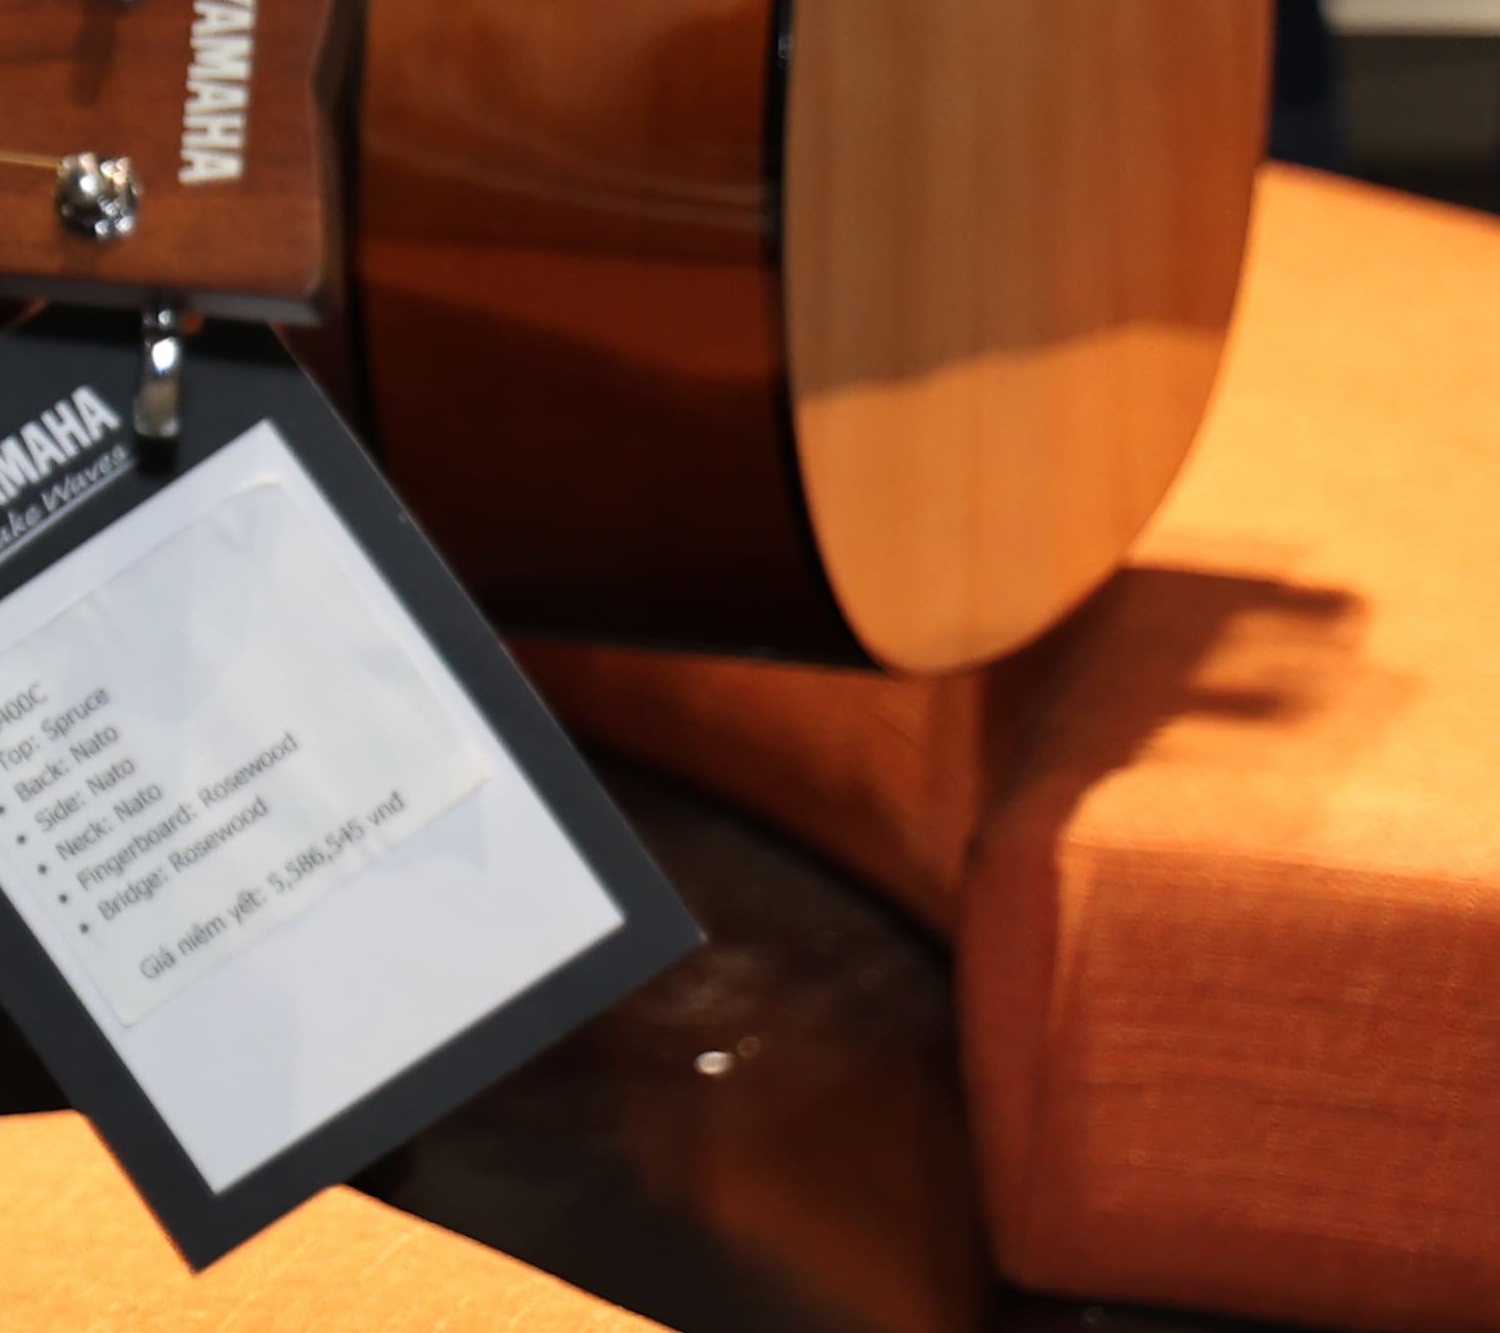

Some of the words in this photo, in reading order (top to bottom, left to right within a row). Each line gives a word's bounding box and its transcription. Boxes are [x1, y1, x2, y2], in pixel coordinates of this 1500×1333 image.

[41, 445, 127, 511] Waves
[41, 688, 110, 744] Spruce
[13, 757, 70, 803] Back:
[69, 723, 120, 764] Nato
[34, 789, 86, 833] Side:
[86, 756, 135, 797] Nato
[54, 816, 113, 861] Neck:
[113, 782, 163, 824] Nato
[76, 803, 198, 891] Fingerboard:
[197, 731, 299, 809] Rosewood
[98, 865, 169, 924] Bridge:
[168, 796, 270, 873] Rosewood
[138, 942, 177, 981] Giá
[267, 820, 365, 894] 5,586,545
